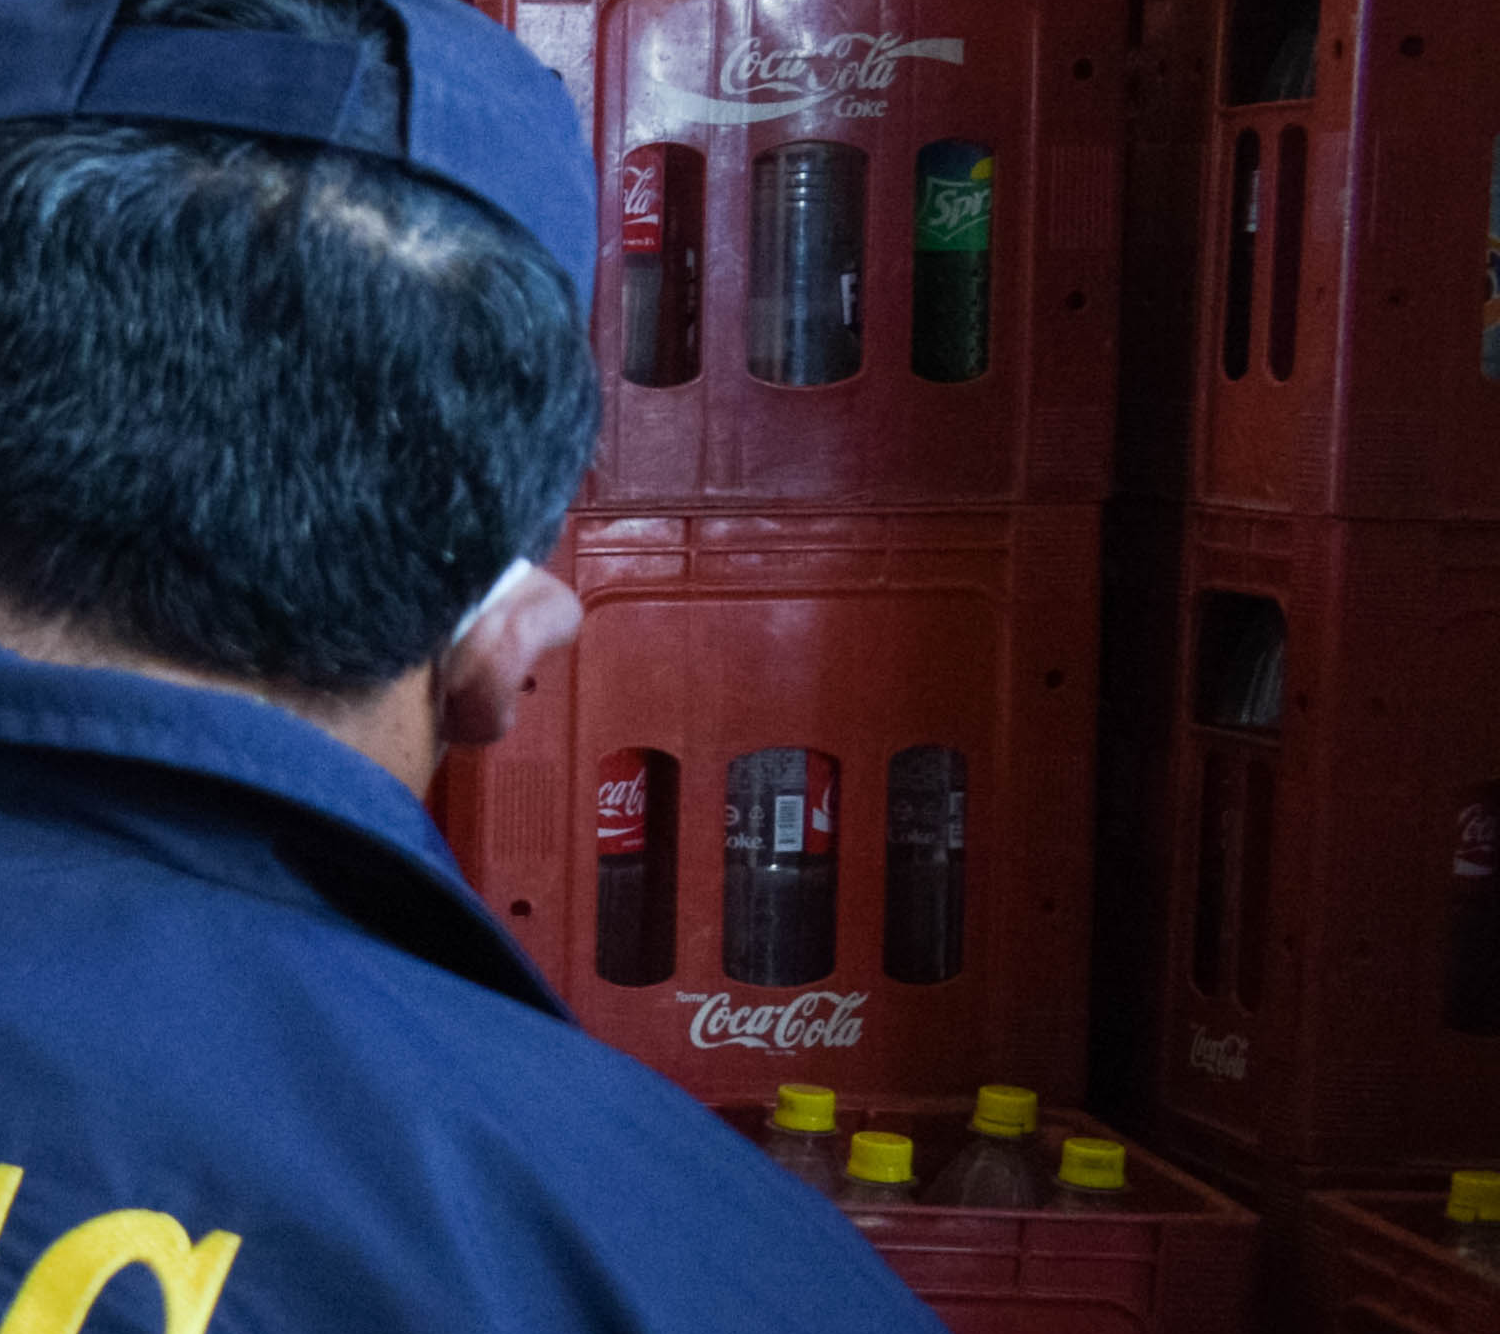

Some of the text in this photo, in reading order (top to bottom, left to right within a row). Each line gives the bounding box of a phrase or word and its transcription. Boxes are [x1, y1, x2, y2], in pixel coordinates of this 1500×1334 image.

[833, 94, 890, 118] Coke
[930, 188, 991, 228] Spr
[690, 991, 869, 1049] Coca-Cola
